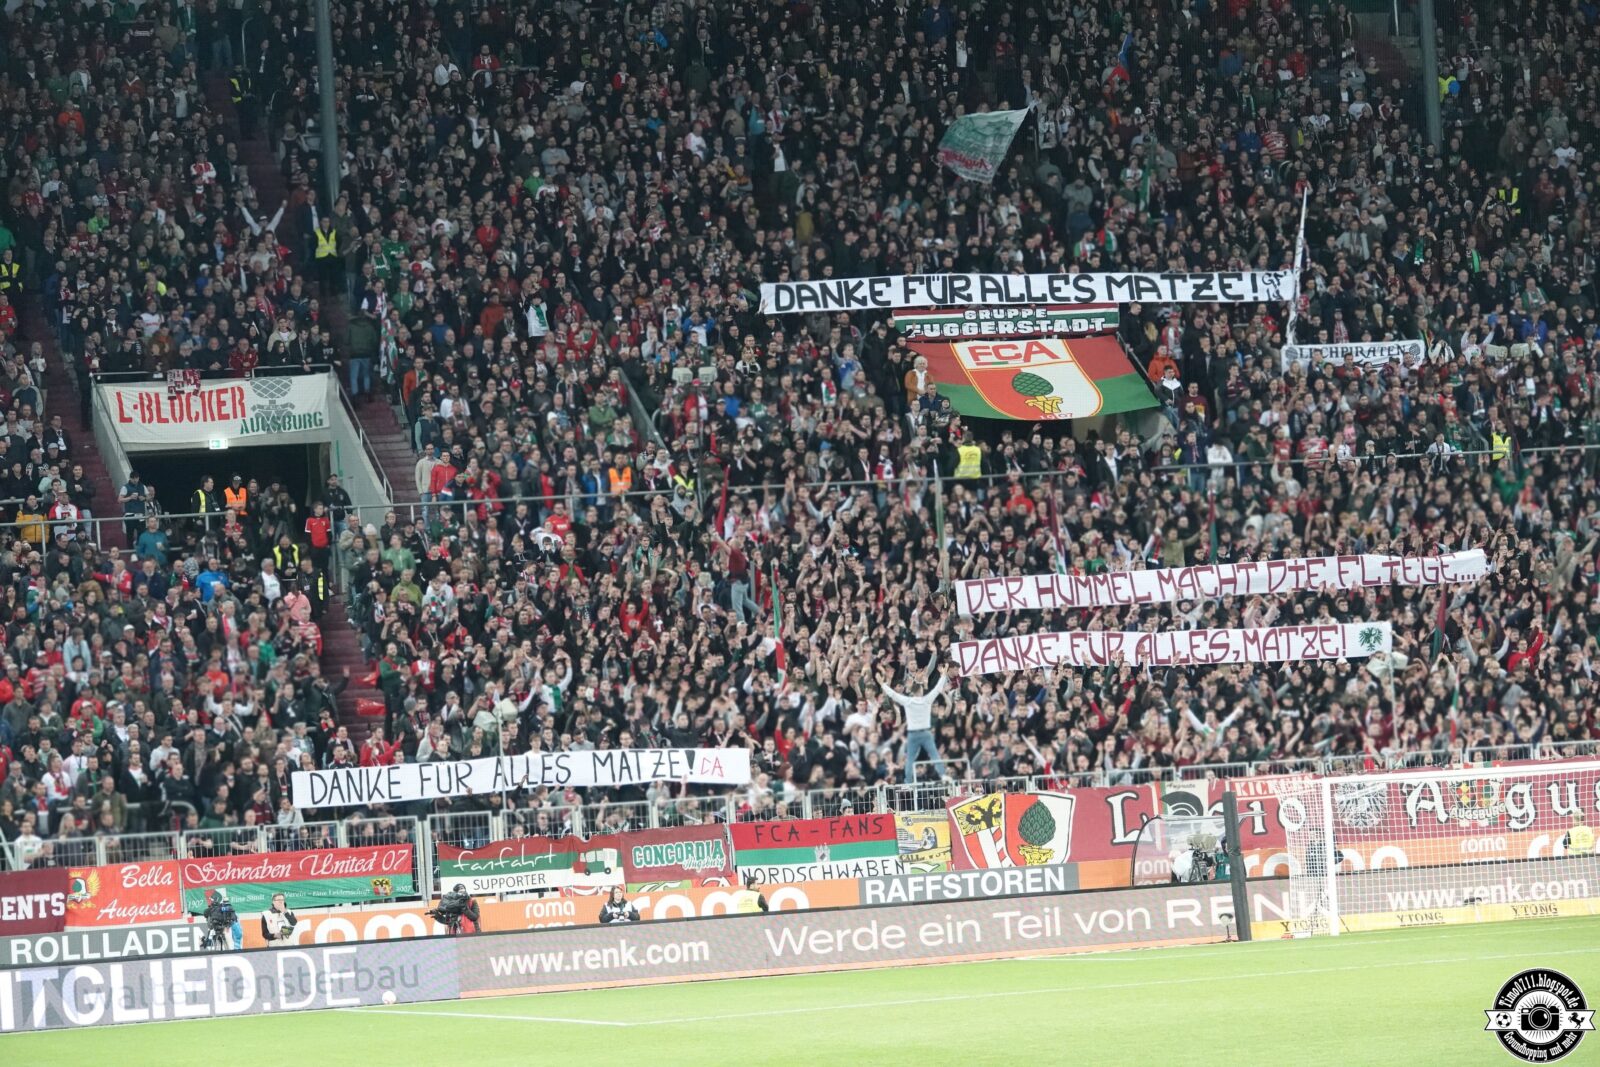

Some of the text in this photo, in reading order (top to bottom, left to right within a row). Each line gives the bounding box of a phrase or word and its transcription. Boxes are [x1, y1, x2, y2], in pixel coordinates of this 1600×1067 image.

[774, 272, 1259, 312] DANKE FÜR ALLES MATZE!
[904, 317, 1107, 339] FUGGERSTADT
[964, 307, 1048, 321] GRUPPE
[967, 340, 1061, 363] FCA
[239, 410, 324, 435] AUGSBURG
[964, 576, 1028, 613] DER
[1034, 571, 1152, 608] HUMMEL
[1156, 561, 1259, 601] MACHT
[1266, 558, 1328, 593] DIE
[957, 632, 1061, 676] DANKE
[1069, 631, 1124, 667] FÜR
[1242, 624, 1347, 664] MATZE!
[309, 749, 696, 806] DANKE FÜR ALLES MATZE!
[753, 824, 801, 845] FCA
[828, 816, 884, 840] FANS
[453, 844, 557, 873] fanfahrt
[631, 838, 726, 869] CONCORDIA
[1460, 836, 1507, 854] roma
[120, 864, 174, 889] Bella
[184, 849, 409, 885] Schwaben United 07
[741, 858, 907, 886] NORDSCHWABEN
[1135, 858, 1170, 876] rom
[473, 873, 546, 891] SUPPORTER
[865, 866, 1065, 905] RAFFSTOREN
[1386, 876, 1589, 912] www.renk.com
[0, 891, 66, 921] ENTS
[96, 898, 177, 924] Augusta
[526, 900, 576, 919] roma
[1396, 911, 1444, 924] YTONG
[1511, 902, 1558, 916] YTONG
[764, 920, 906, 958] Werde
[918, 914, 982, 947] ein
[992, 906, 1062, 940] Teil
[1074, 906, 1151, 936] von
[489, 939, 710, 978] www.renk.com
